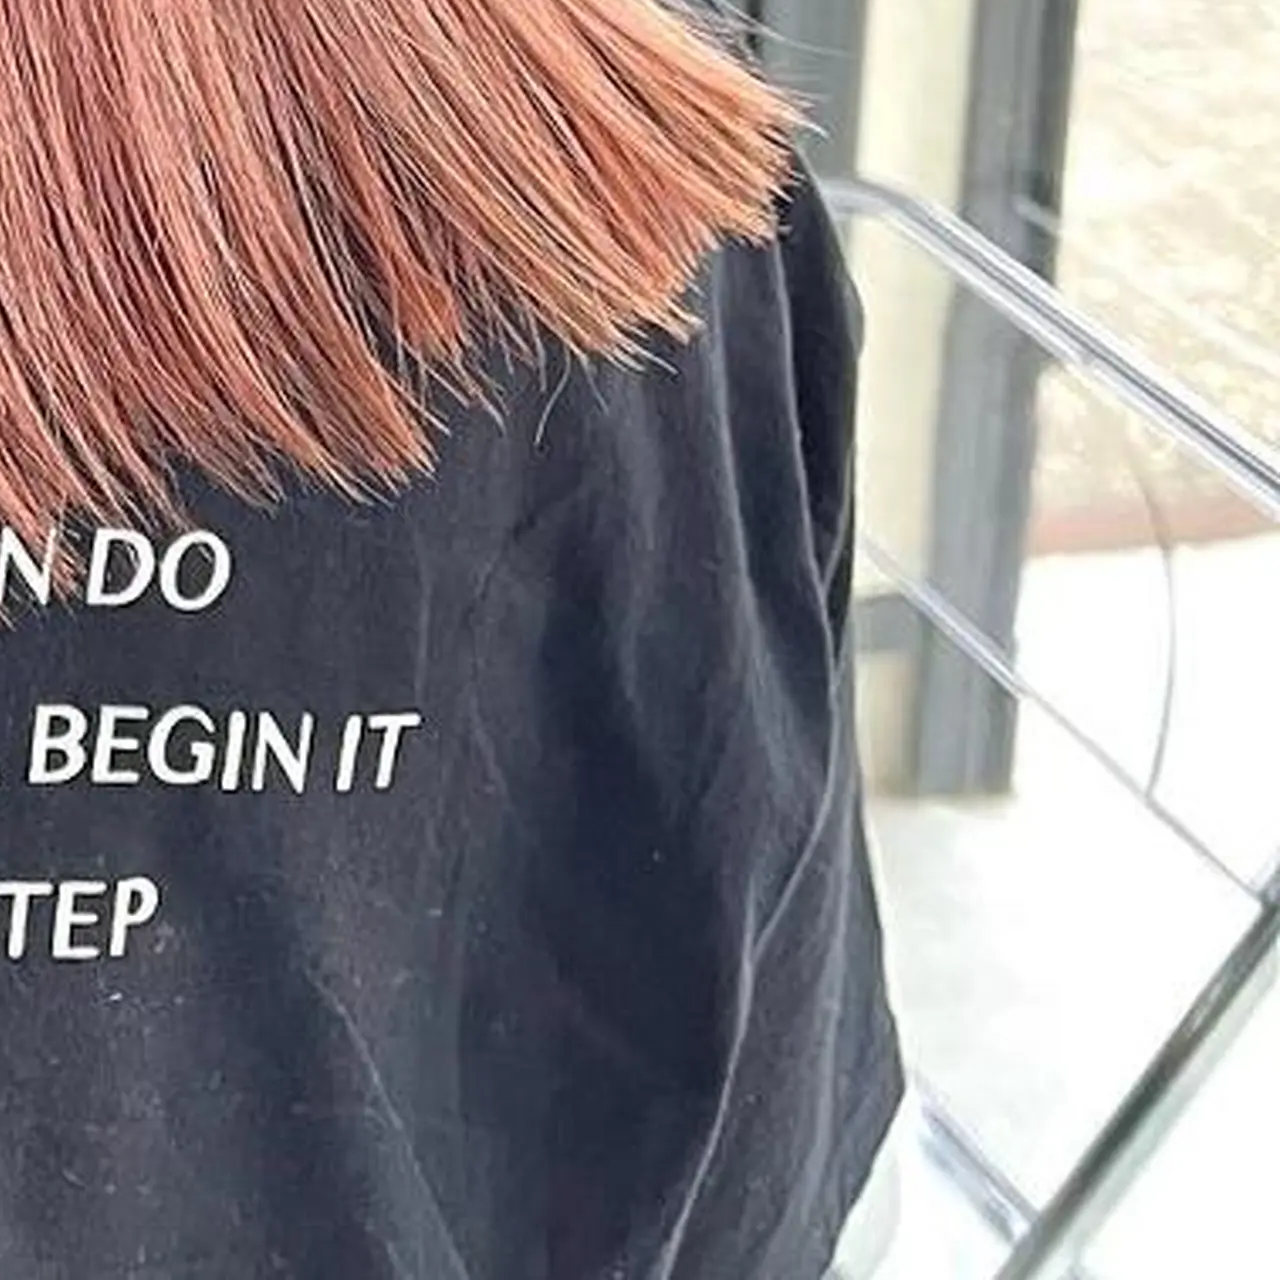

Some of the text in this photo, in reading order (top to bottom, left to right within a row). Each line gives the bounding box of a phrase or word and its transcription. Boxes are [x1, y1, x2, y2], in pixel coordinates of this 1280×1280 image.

[86, 526, 233, 611] DO
[27, 703, 313, 794] BEGIN
[334, 712, 422, 792] IT
